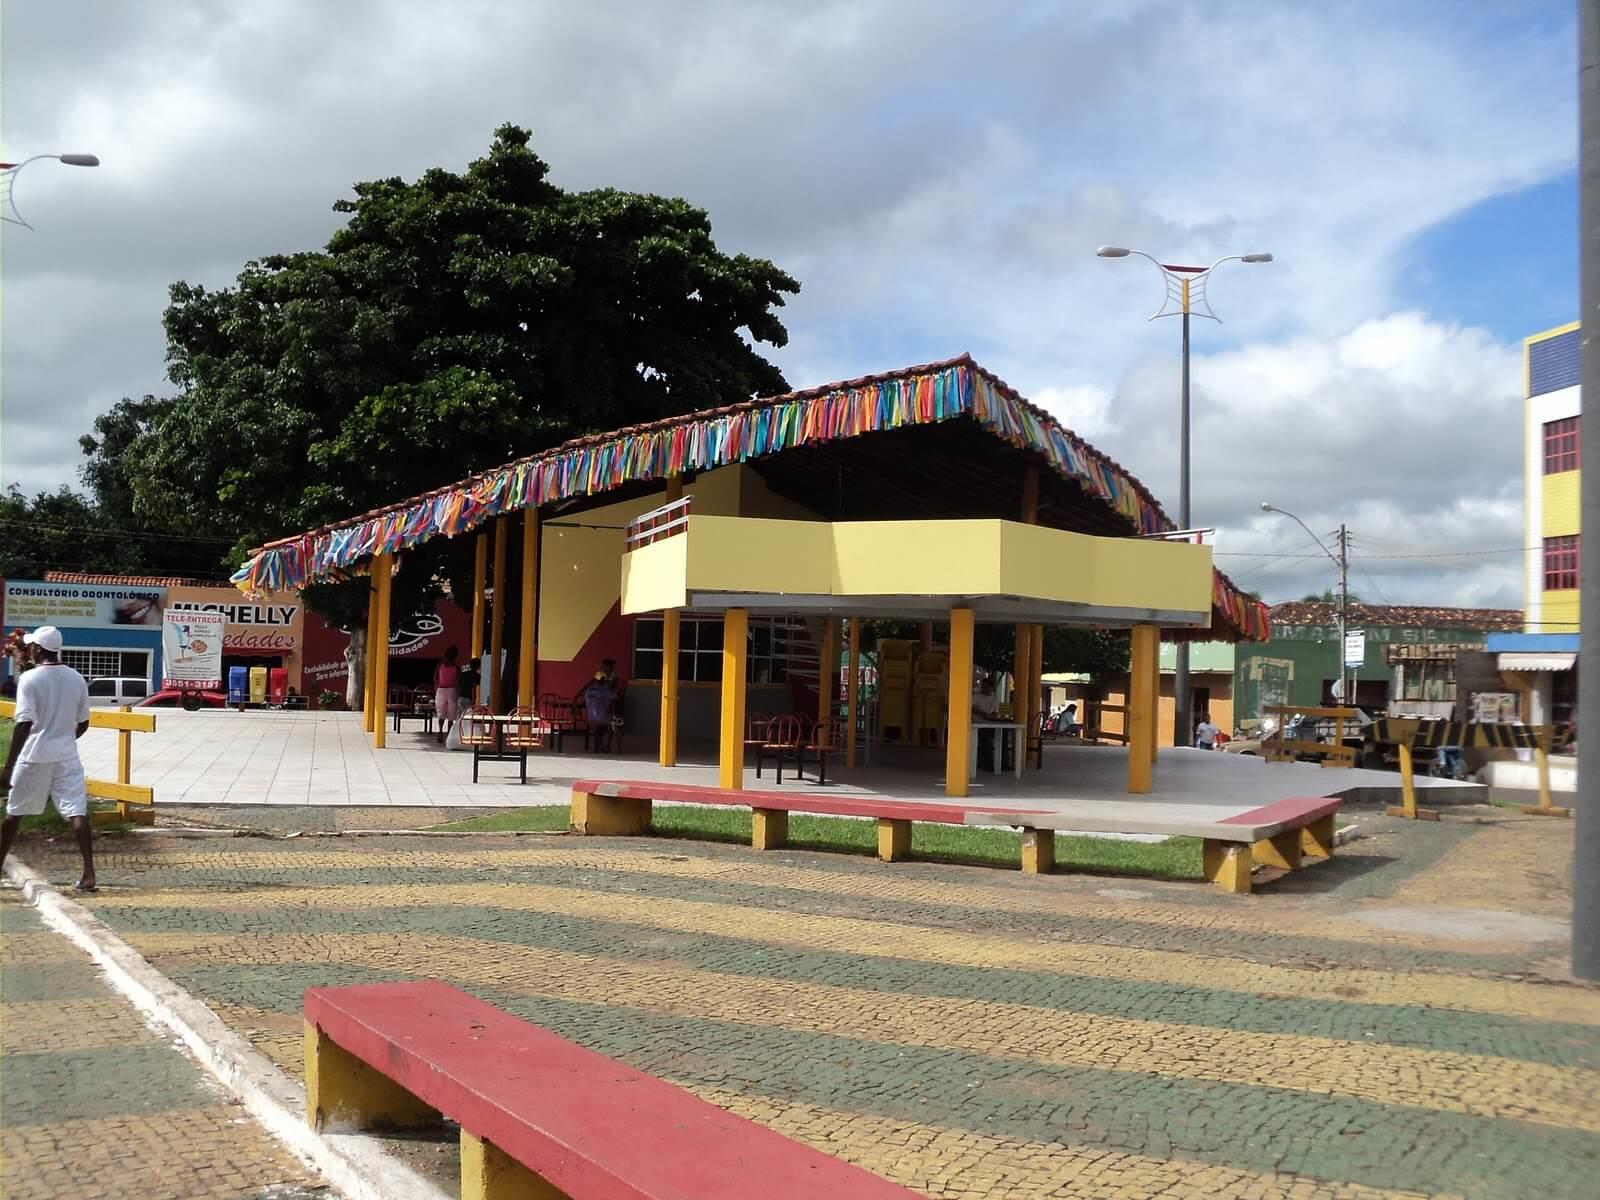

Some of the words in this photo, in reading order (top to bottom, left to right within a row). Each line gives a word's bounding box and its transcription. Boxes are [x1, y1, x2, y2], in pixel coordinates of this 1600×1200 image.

[8, 587, 79, 598] CONSULTÓRIO
[81, 589, 160, 600] ODONTOLÓGICO
[167, 614, 223, 625] TELE-ENTREGA
